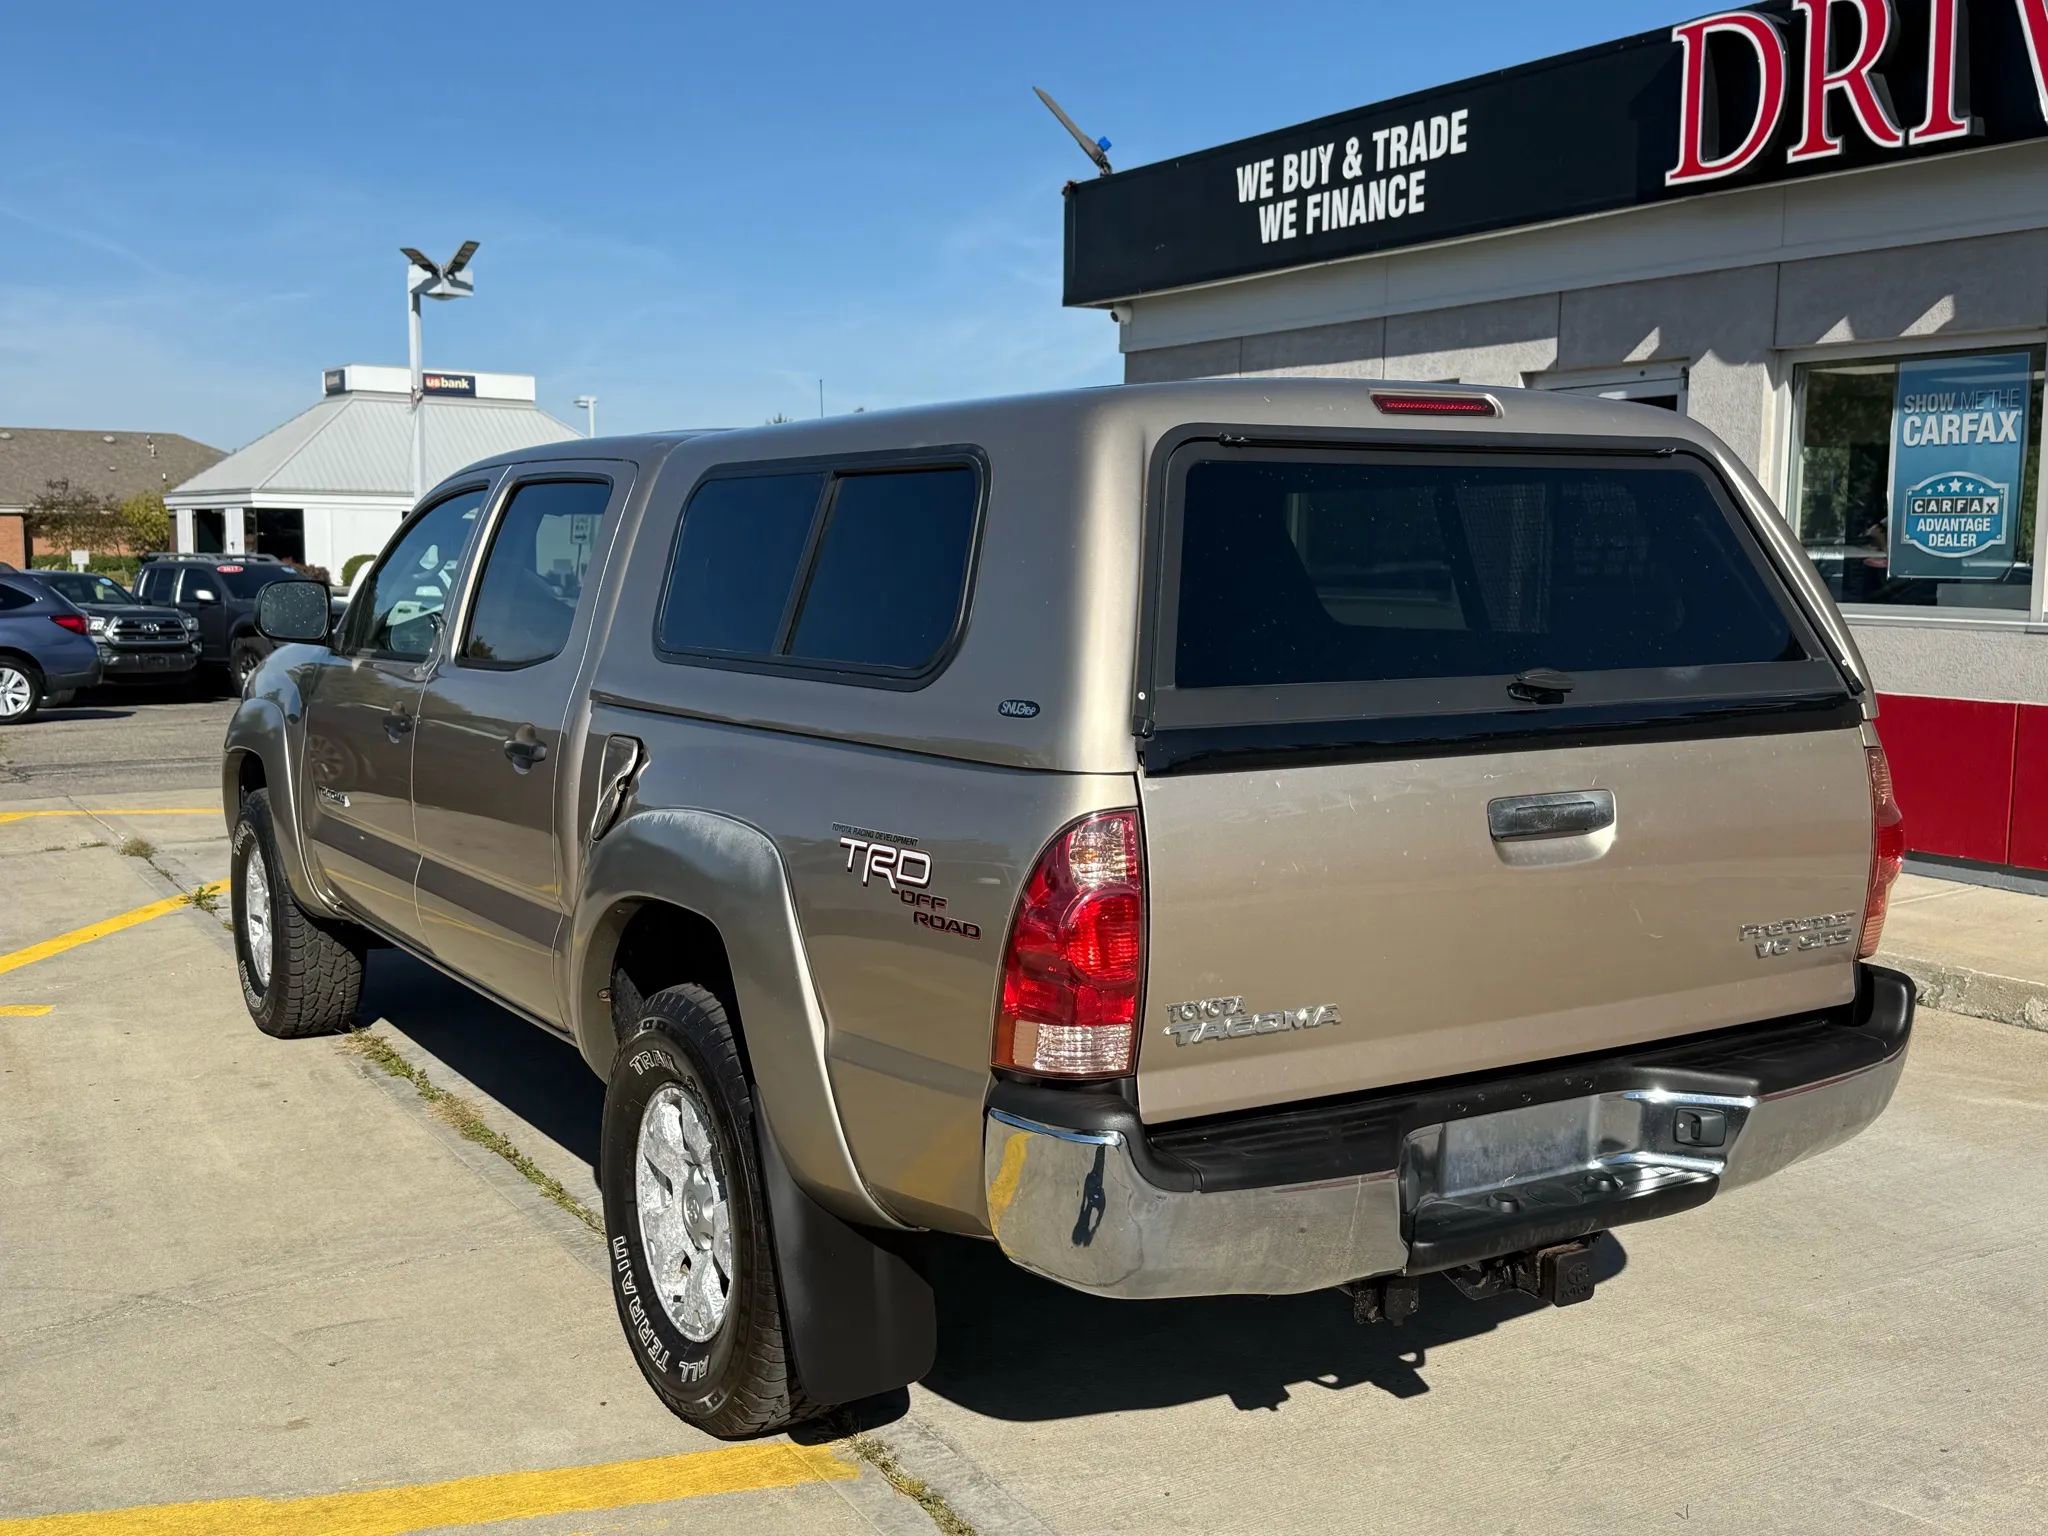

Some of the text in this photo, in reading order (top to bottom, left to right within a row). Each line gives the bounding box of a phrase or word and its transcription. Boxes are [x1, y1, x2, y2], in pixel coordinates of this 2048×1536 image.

[1236, 108, 1469, 203] WE BUY & TRADE
[1258, 169, 1426, 244] WE FINANCE
[1903, 387, 2021, 414] SHOW ME THE
[1913, 499, 1998, 515] CARFAX
[1916, 517, 1991, 532] ADVANTAGE
[1928, 532, 1977, 547] DEALER
[875, 833, 919, 847] DEVELOPMENT
[840, 836, 932, 894] TRD
[900, 889, 948, 909] OFF
[913, 910, 982, 940] ROAD
[1166, 995, 1246, 1023] TOYOTA
[1163, 1003, 1342, 1047] TACOMA
[678, 1355, 710, 1382] ALL
